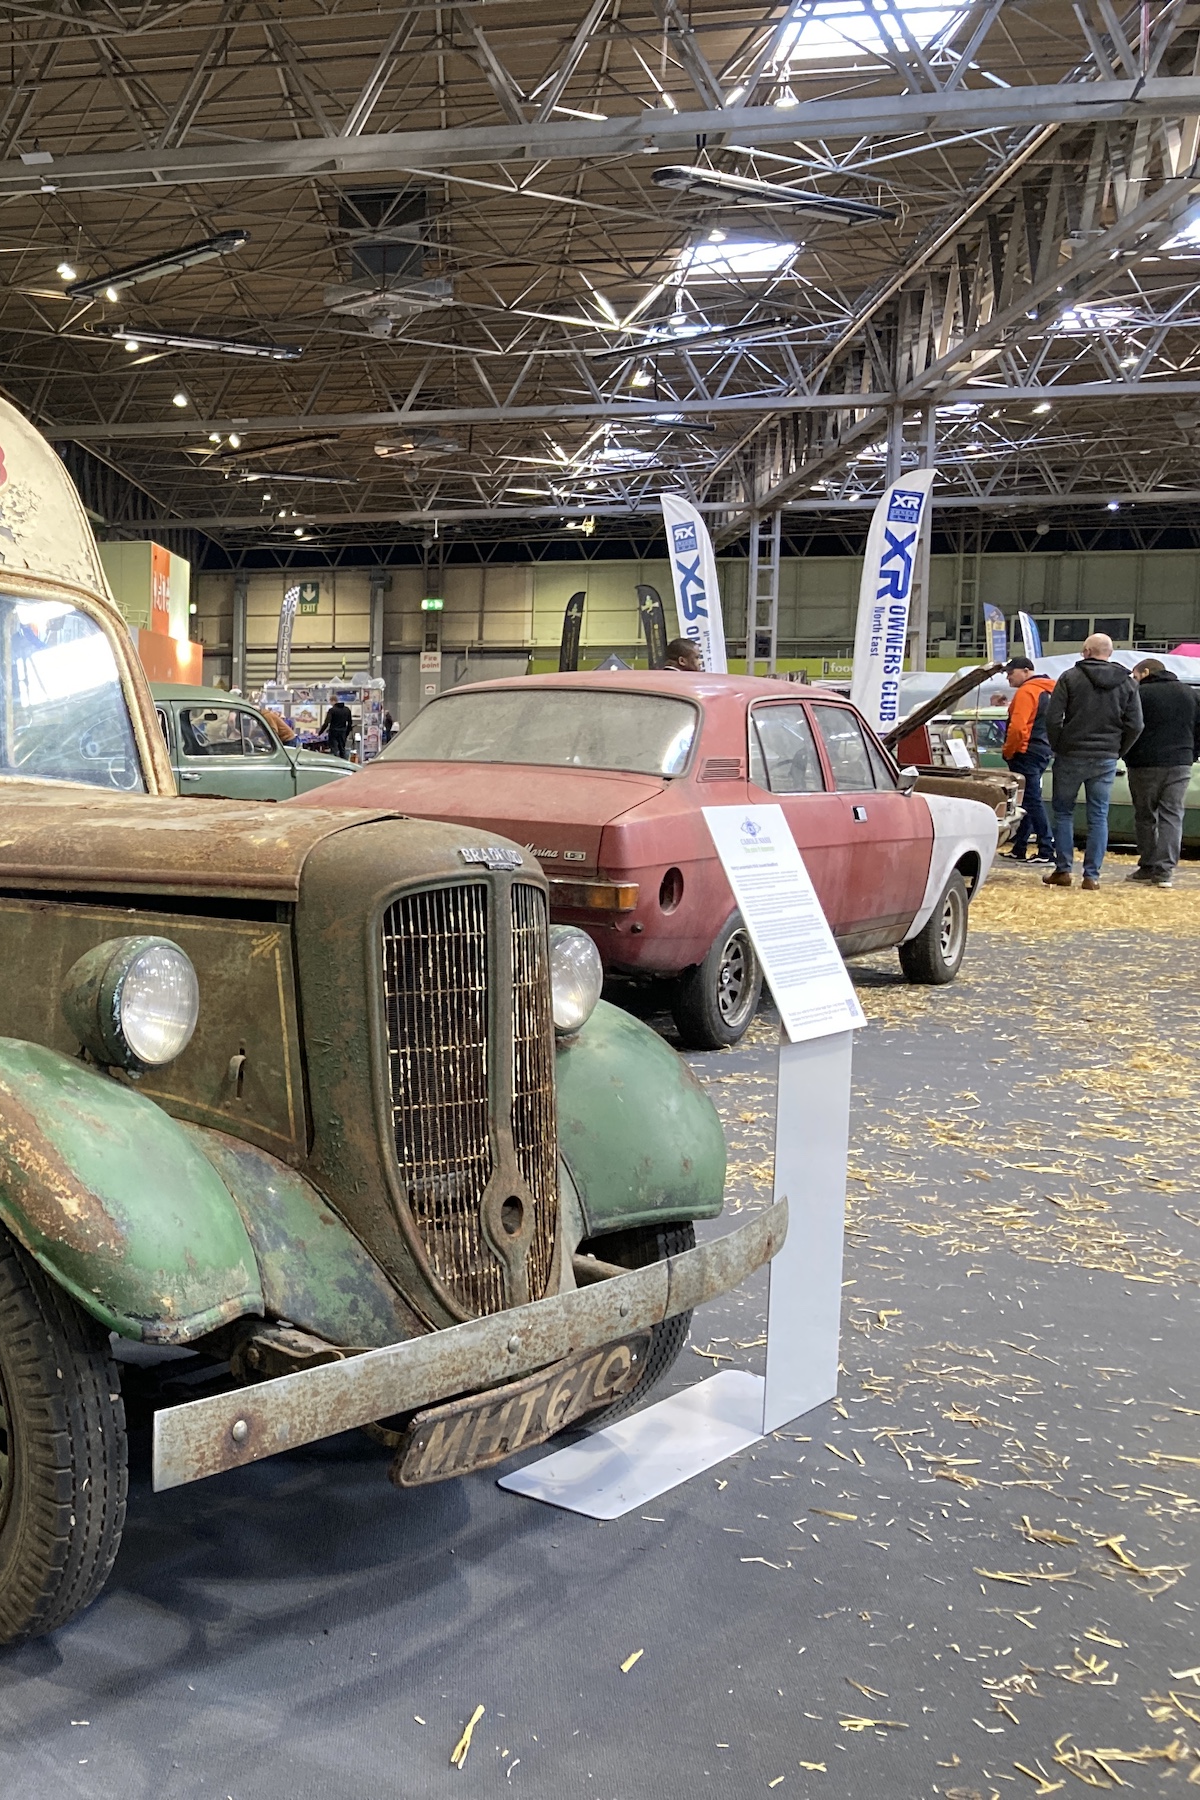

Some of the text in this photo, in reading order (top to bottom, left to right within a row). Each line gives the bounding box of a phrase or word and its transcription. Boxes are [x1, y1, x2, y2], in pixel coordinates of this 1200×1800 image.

[891, 495, 920, 509] XR
[876, 526, 917, 599] XR
[302, 603, 316, 612] EXIT
[280, 600, 294, 664] VIPER
[870, 606, 886, 656] North East
[883, 605, 907, 674] OWNERS
[831, 662, 853, 673] foo
[879, 681, 899, 722] CLUB
[523, 843, 559, 858] Marina
